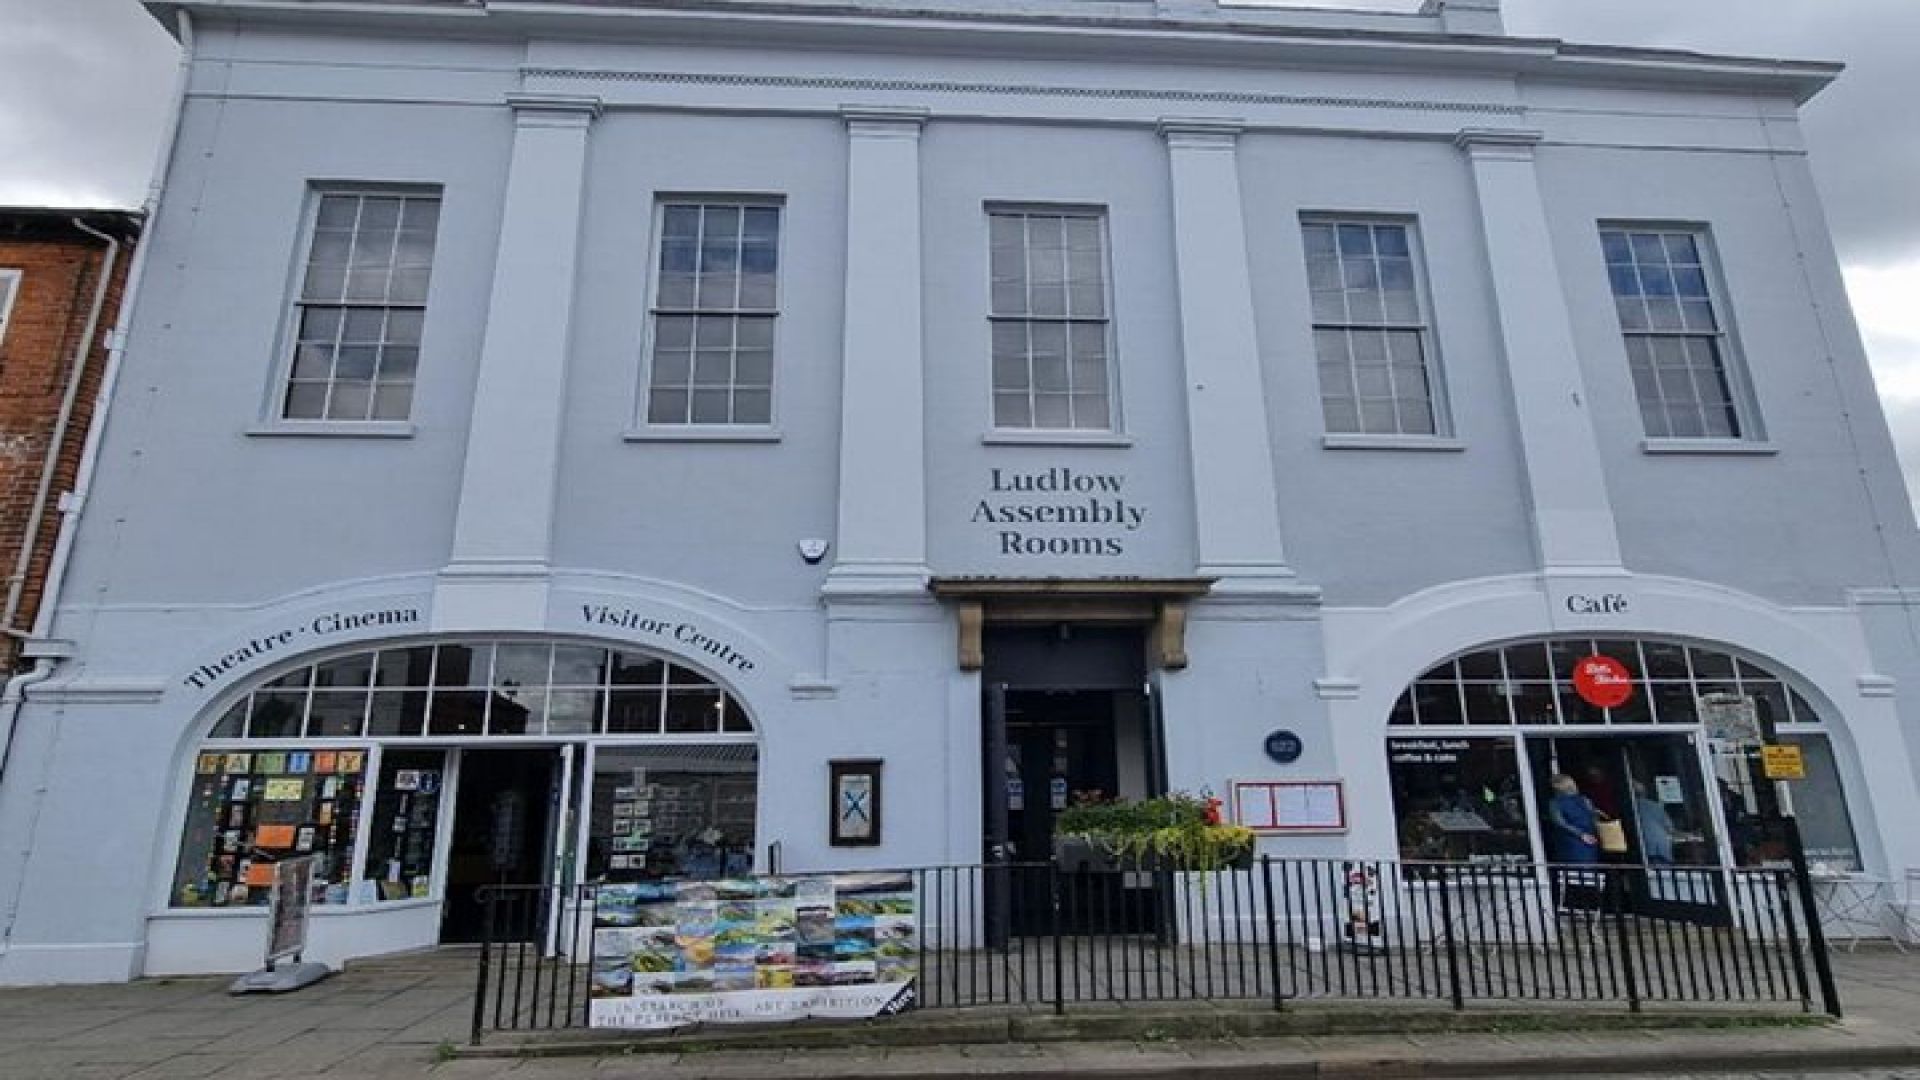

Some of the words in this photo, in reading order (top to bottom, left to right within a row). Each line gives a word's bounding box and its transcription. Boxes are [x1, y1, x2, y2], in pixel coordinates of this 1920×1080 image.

[990, 467, 1125, 492] Ludlow
[970, 499, 1148, 531] Assembly
[1000, 530, 1124, 557] Rooms
[1566, 594, 1629, 614] Café
[183, 629, 293, 690] Theatre
[311, 608, 419, 635] Cinema
[583, 604, 671, 635] Visitor
[674, 623, 756, 672] Centre
